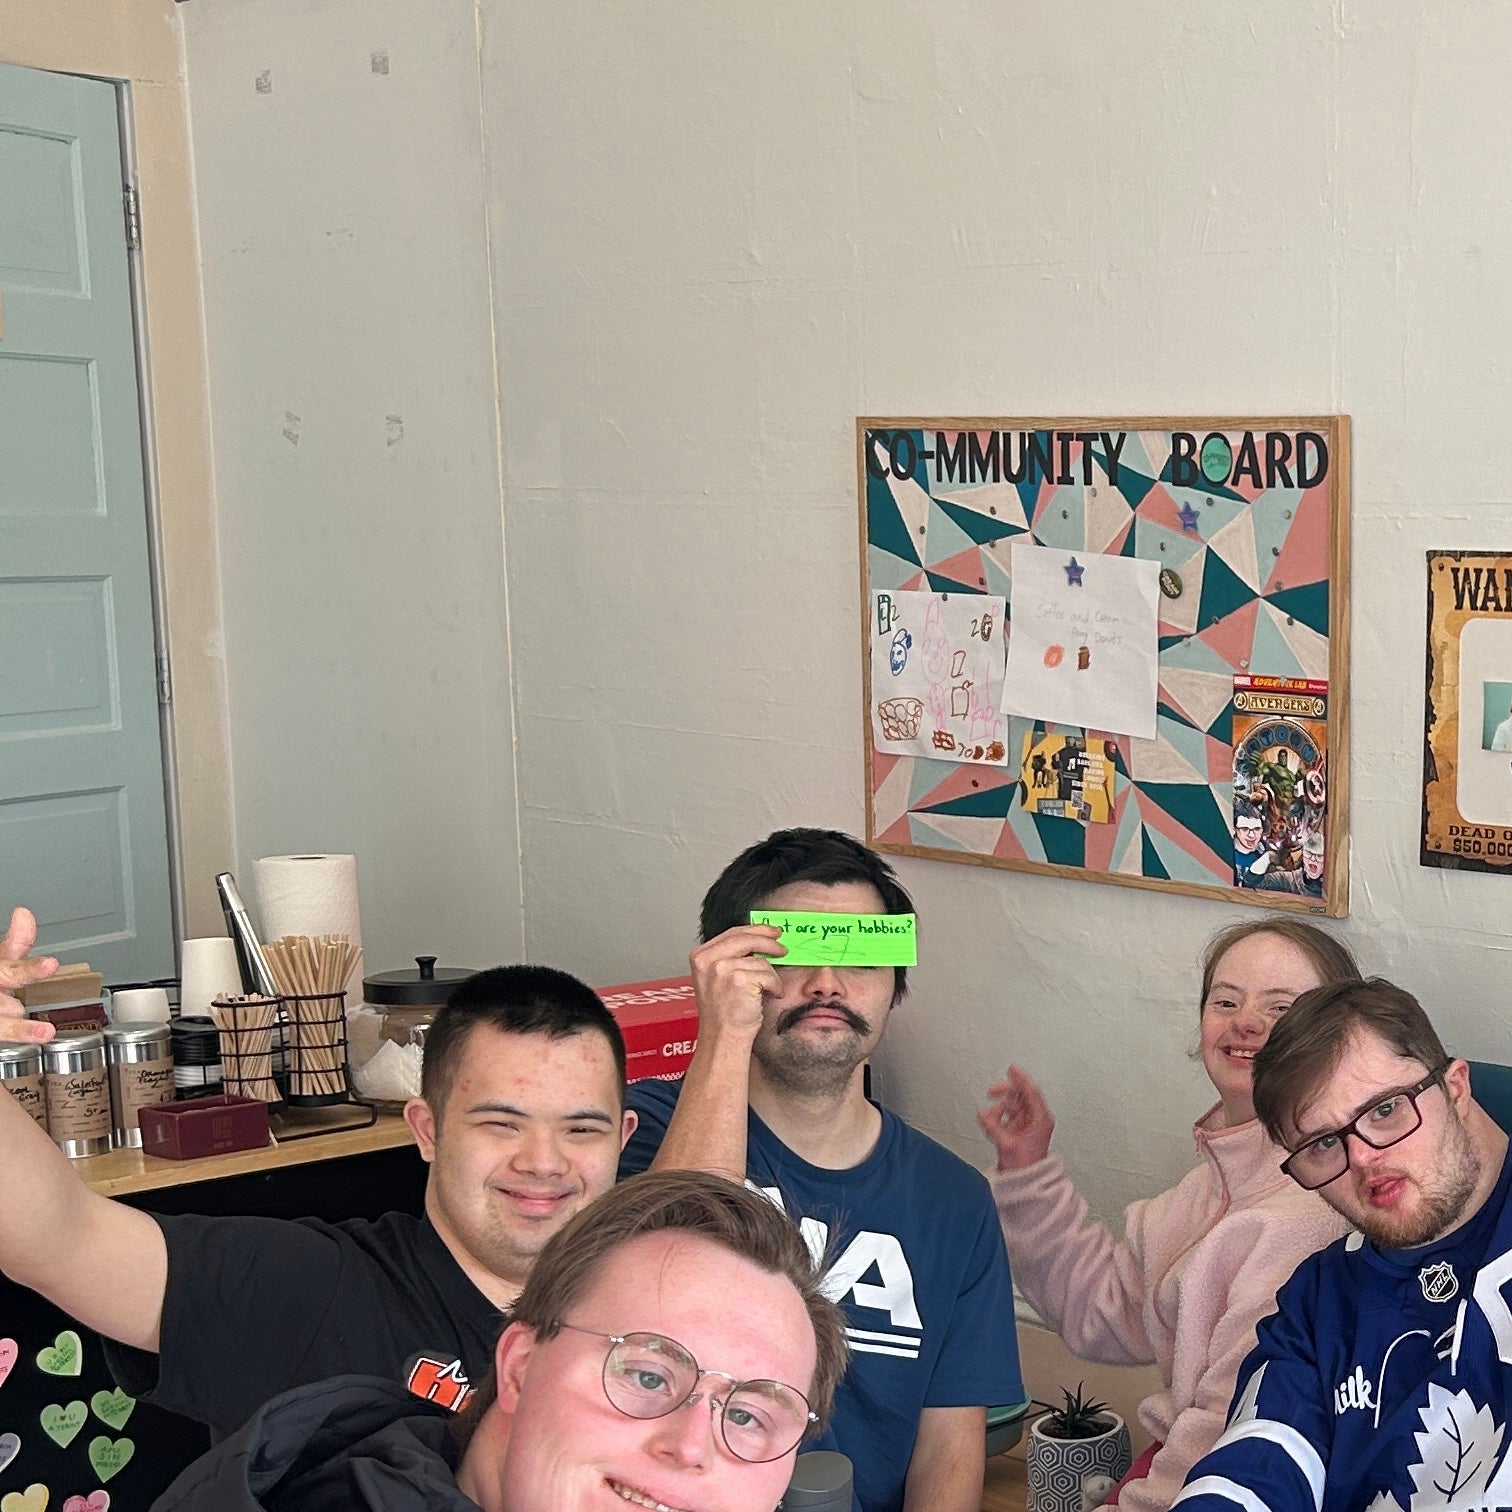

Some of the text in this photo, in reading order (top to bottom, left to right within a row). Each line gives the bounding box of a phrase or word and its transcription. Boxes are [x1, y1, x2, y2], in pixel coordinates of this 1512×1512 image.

[866, 429, 1330, 489] CO-MMUNITY BOARD
[1250, 696, 1310, 712] AVENGERS
[1449, 825, 1495, 839] DEAD
[795, 924, 817, 934] are
[821, 925, 853, 940] your
[858, 919, 913, 934] hobbies?
[1430, 1273, 1449, 1296] NHL
